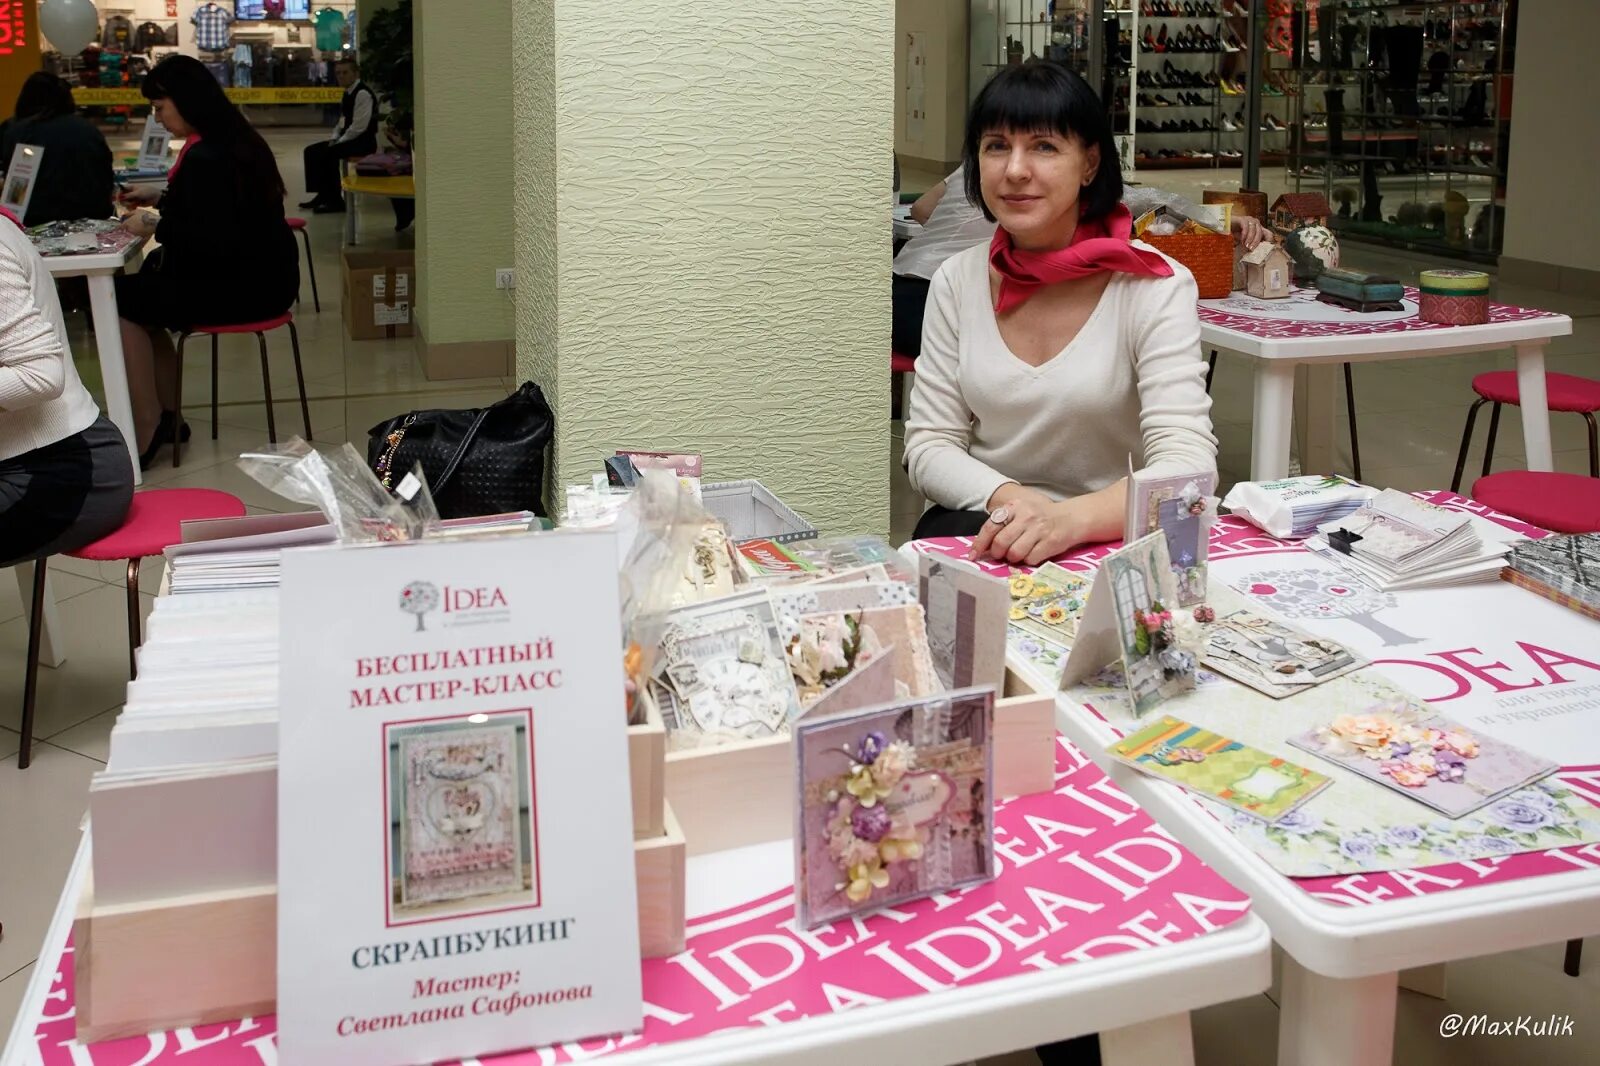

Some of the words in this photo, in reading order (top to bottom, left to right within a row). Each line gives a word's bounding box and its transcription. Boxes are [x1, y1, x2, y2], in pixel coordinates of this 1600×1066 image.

[443, 586, 509, 613] IDEA
[355, 637, 555, 678] БЕСПЛАТНЫЙ
[349, 670, 563, 709] МАСТЕР-КЛАСС
[351, 917, 576, 970] СКРАПБУКИНГ
[864, 886, 1105, 993] IDEA
[412, 969, 521, 999] Мастер:
[336, 1005, 465, 1037] Светлана
[472, 984, 593, 1016] Сафонова
